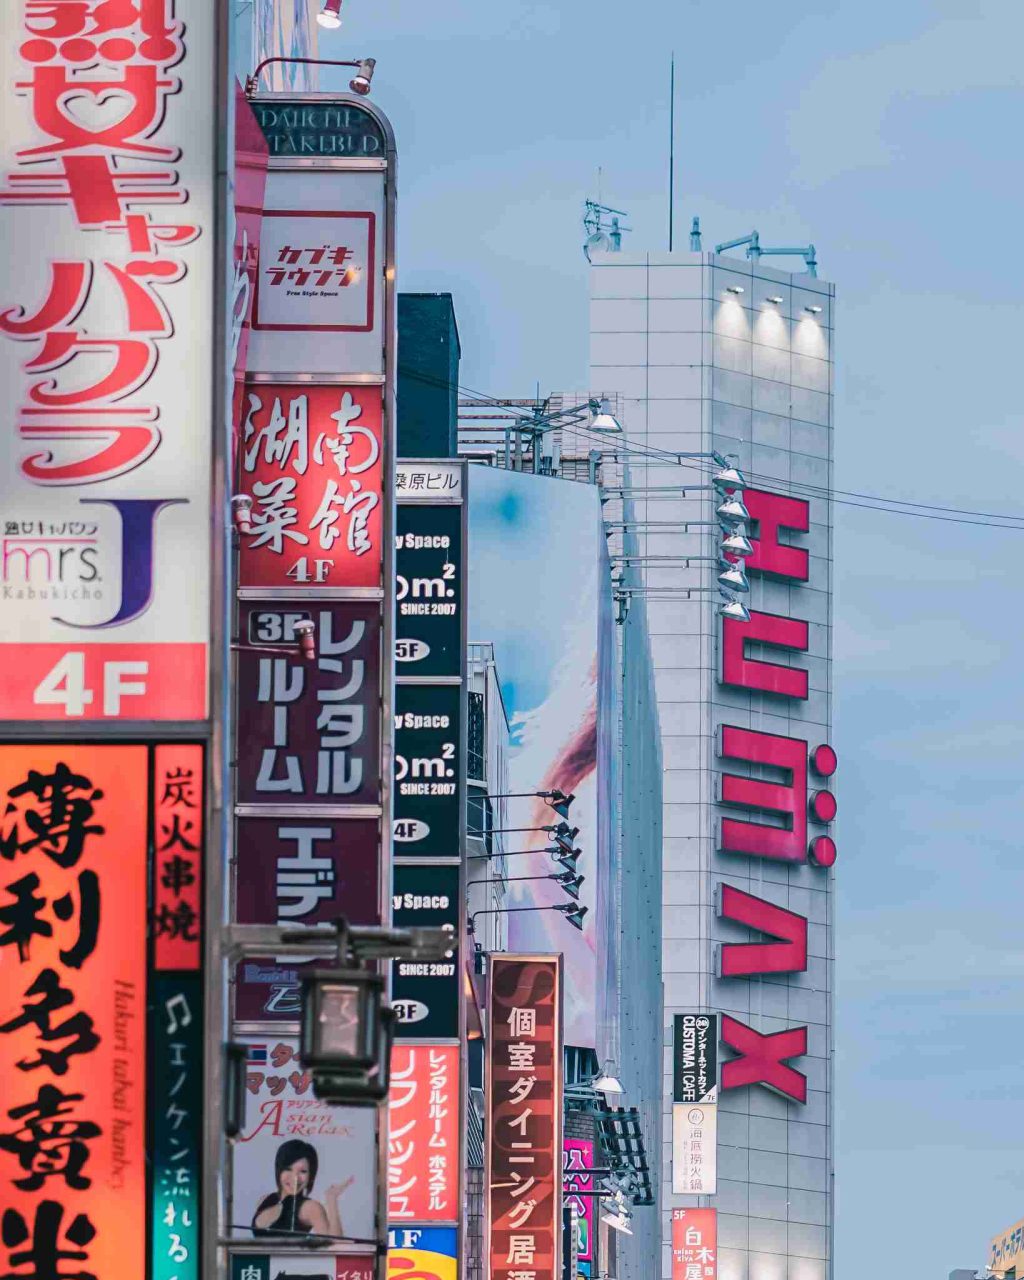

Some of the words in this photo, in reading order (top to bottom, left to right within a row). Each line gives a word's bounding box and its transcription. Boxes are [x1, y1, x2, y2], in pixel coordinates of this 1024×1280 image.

[278, 245, 354, 264] カブキ
[243, 392, 380, 475] 湖南
[405, 533, 450, 549] Space
[286, 557, 335, 582] 4F
[3, 585, 103, 599] Kabukicho
[400, 603, 430, 616] SINCE
[431, 603, 456, 616] 2007
[396, 642, 420, 658] 5F
[33, 652, 149, 716] 4F
[317, 611, 366, 794] レンタル
[256, 658, 305, 794] ルーム
[403, 713, 449, 729] Space
[400, 783, 429, 795] SINCE
[430, 783, 455, 795] 2007
[394, 822, 418, 838] 4F
[404, 893, 449, 909] Space
[400, 964, 428, 976] SINCE
[430, 964, 455, 976] 2007
[682, 1015, 696, 1069] CUSTOMA
[428, 1050, 448, 1148] レンタルルーム
[428, 1154, 448, 1211] ホステル
[674, 1210, 686, 1220] 5F
